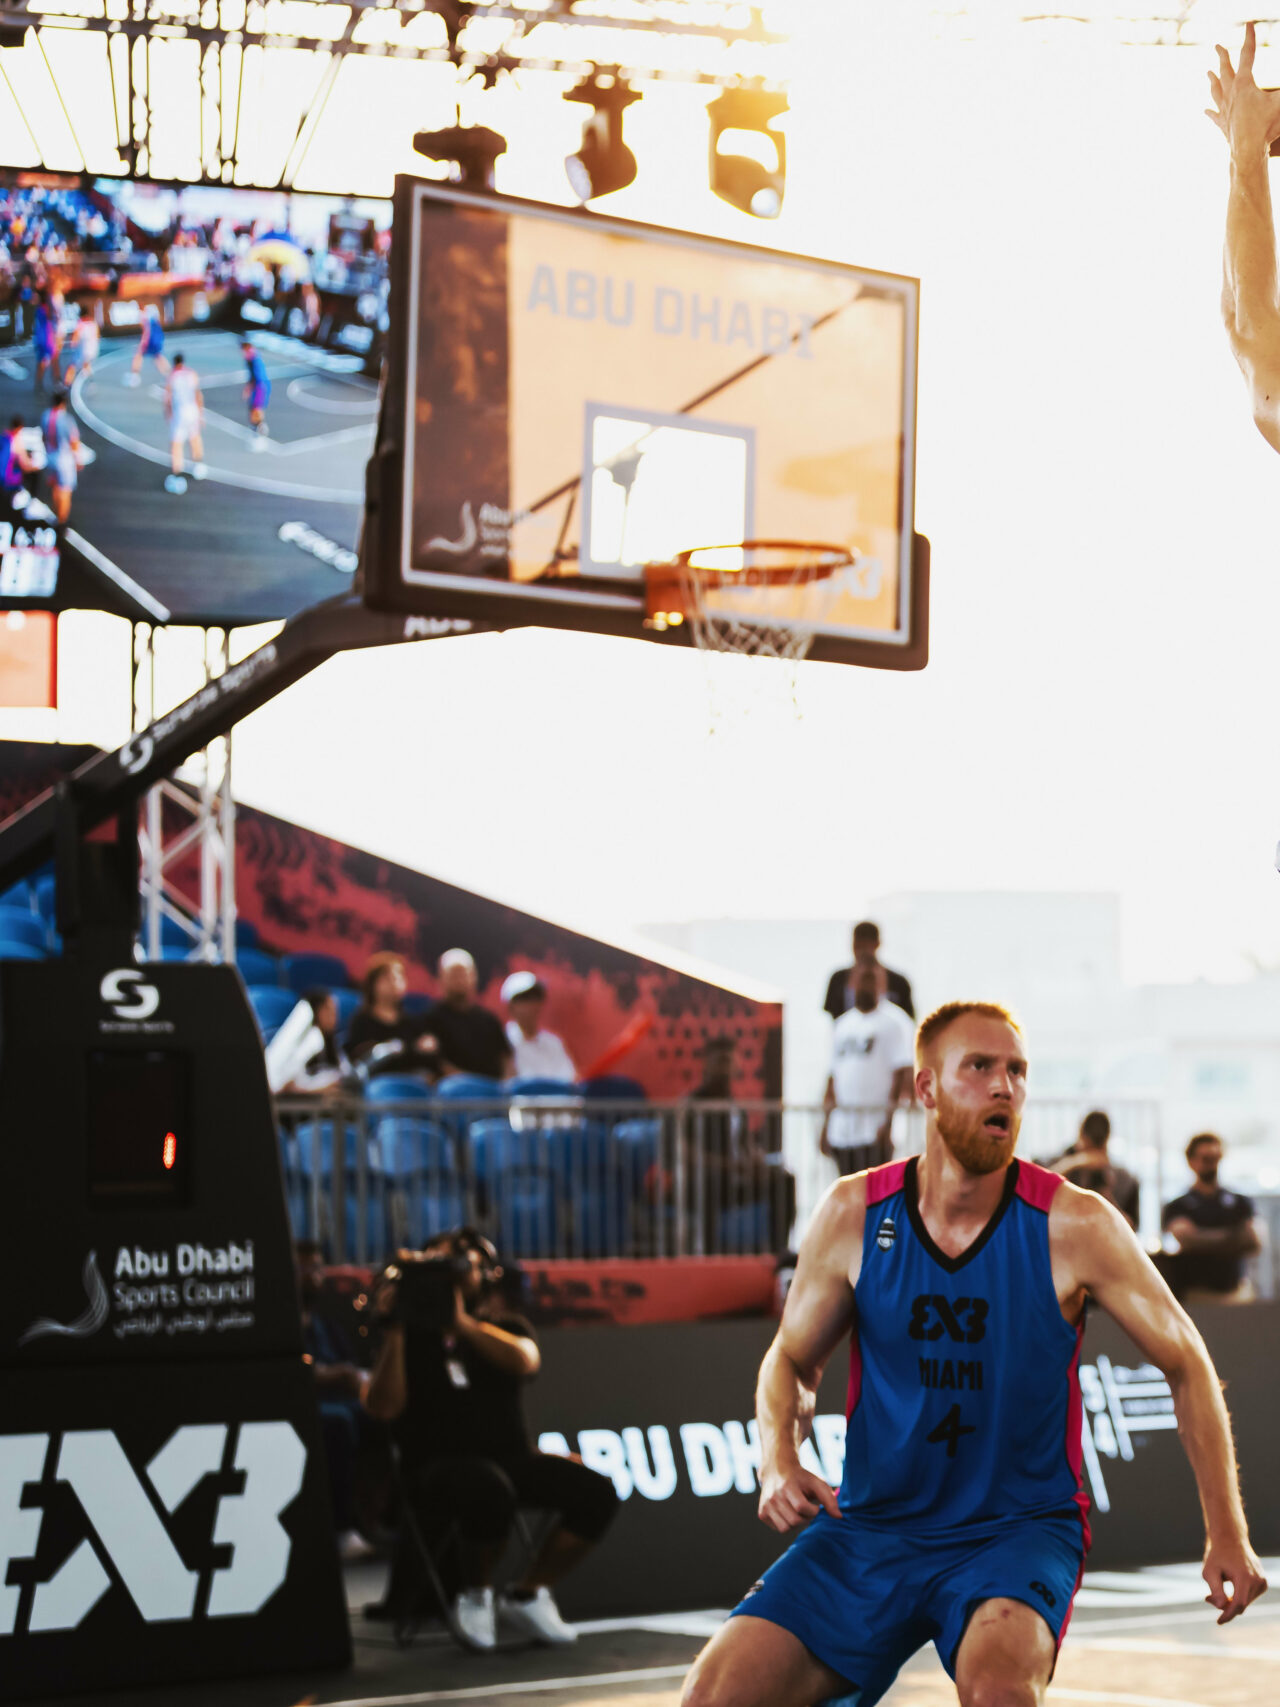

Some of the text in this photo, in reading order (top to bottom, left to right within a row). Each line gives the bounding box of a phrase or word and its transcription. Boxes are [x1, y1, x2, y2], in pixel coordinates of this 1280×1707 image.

[527, 262, 816, 361] ABU DHABI
[114, 1238, 254, 1278] Abu Dhabi
[113, 1276, 255, 1313] Sports Council
[918, 1357, 984, 1391] MIAMI
[926, 1403, 976, 1458] 4
